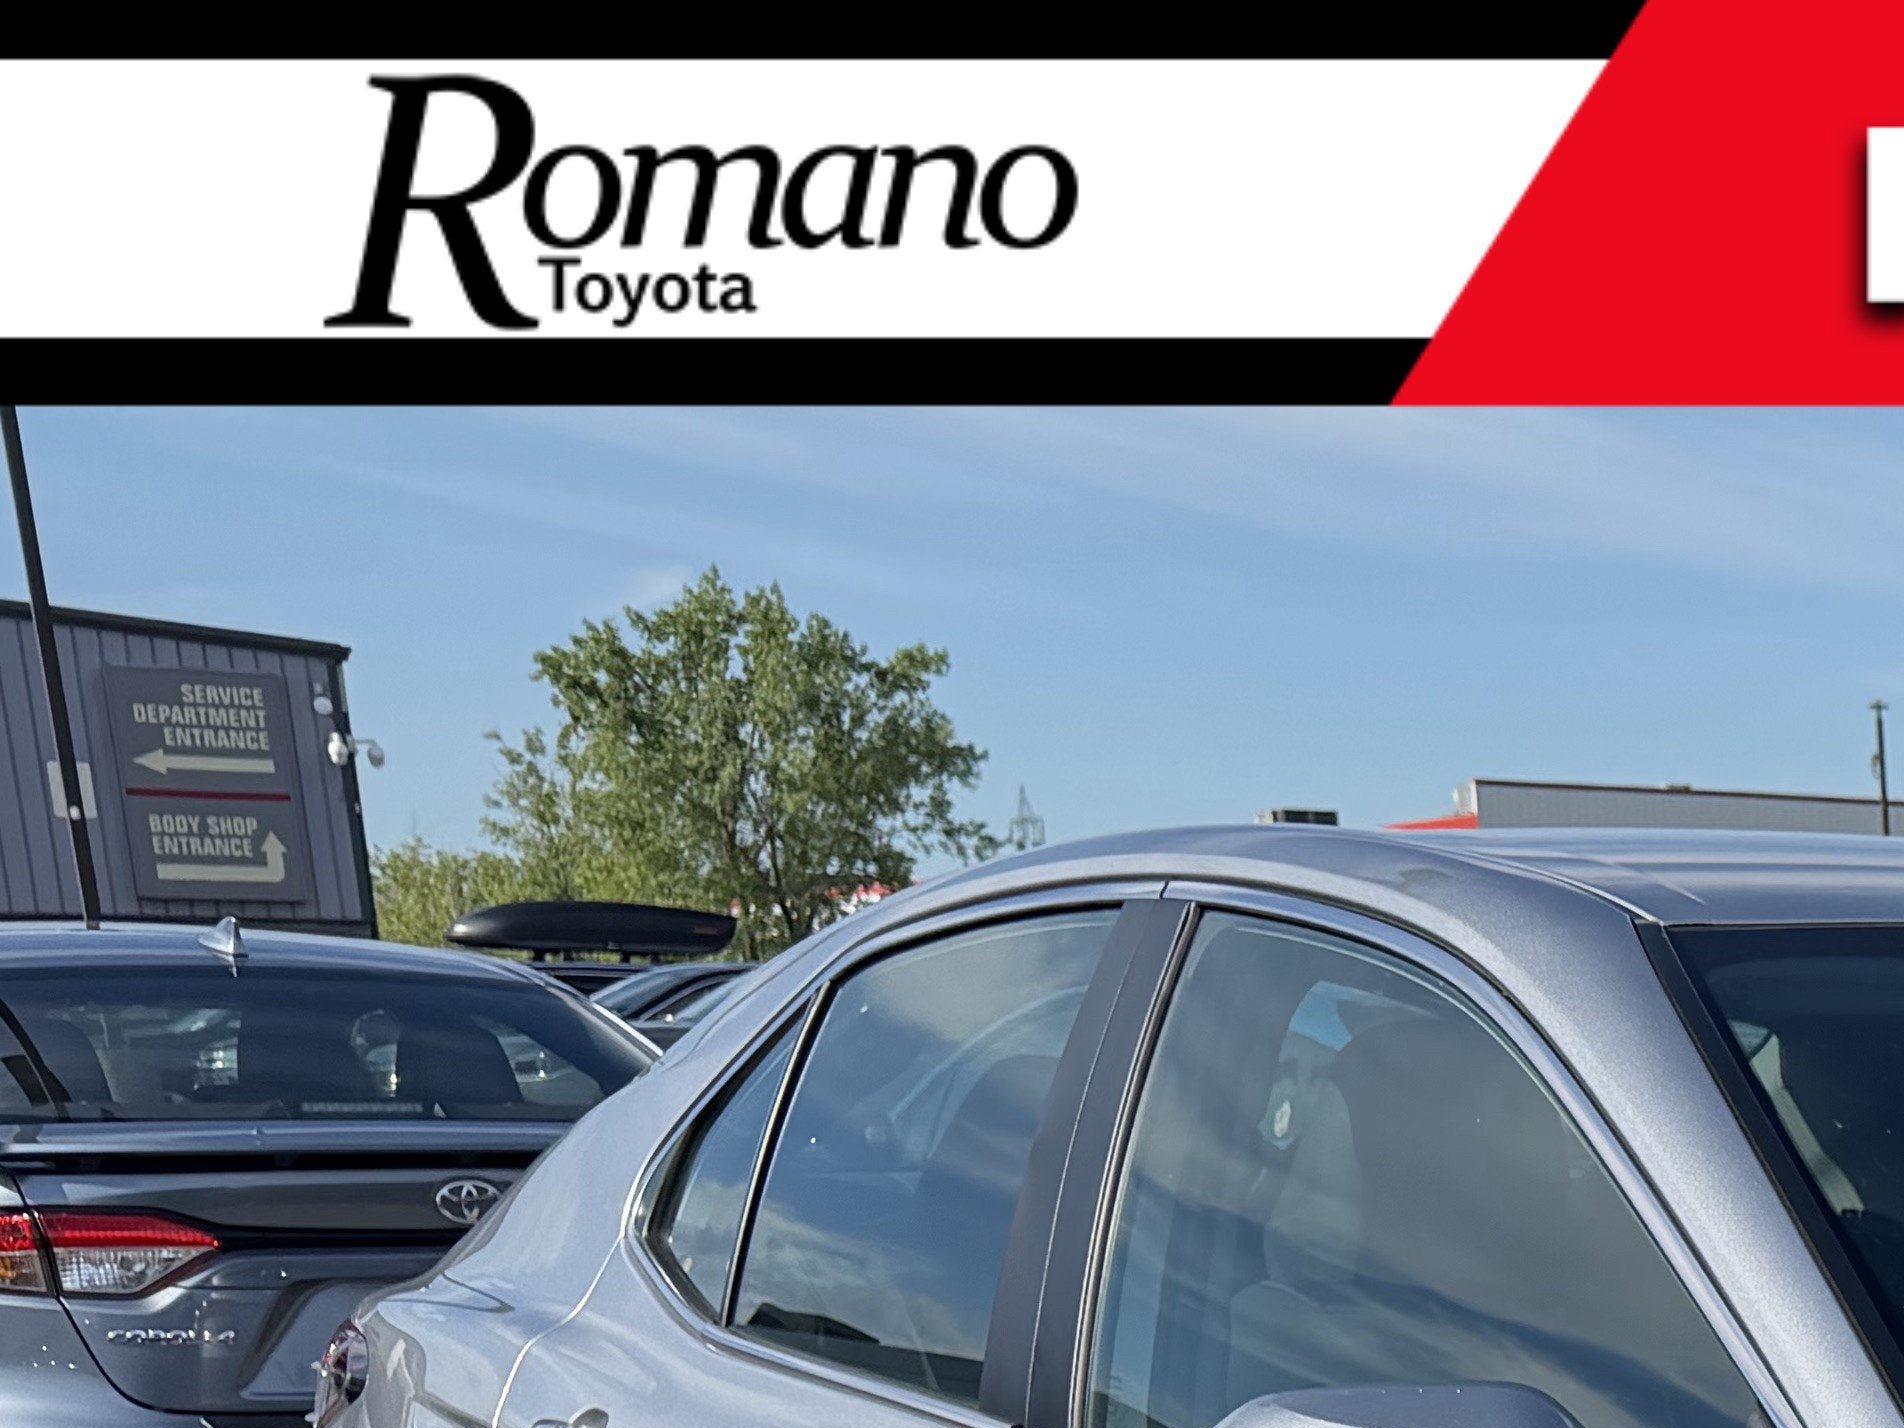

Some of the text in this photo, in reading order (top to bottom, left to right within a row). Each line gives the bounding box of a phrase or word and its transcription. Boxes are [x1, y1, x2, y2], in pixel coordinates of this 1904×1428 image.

[180, 683, 265, 707] SERVICE
[132, 702, 267, 728] DEPARTMENT
[163, 726, 271, 751] ENTRANCE
[148, 813, 258, 836] BODY SHOP
[152, 835, 254, 858] ENTRANCE
